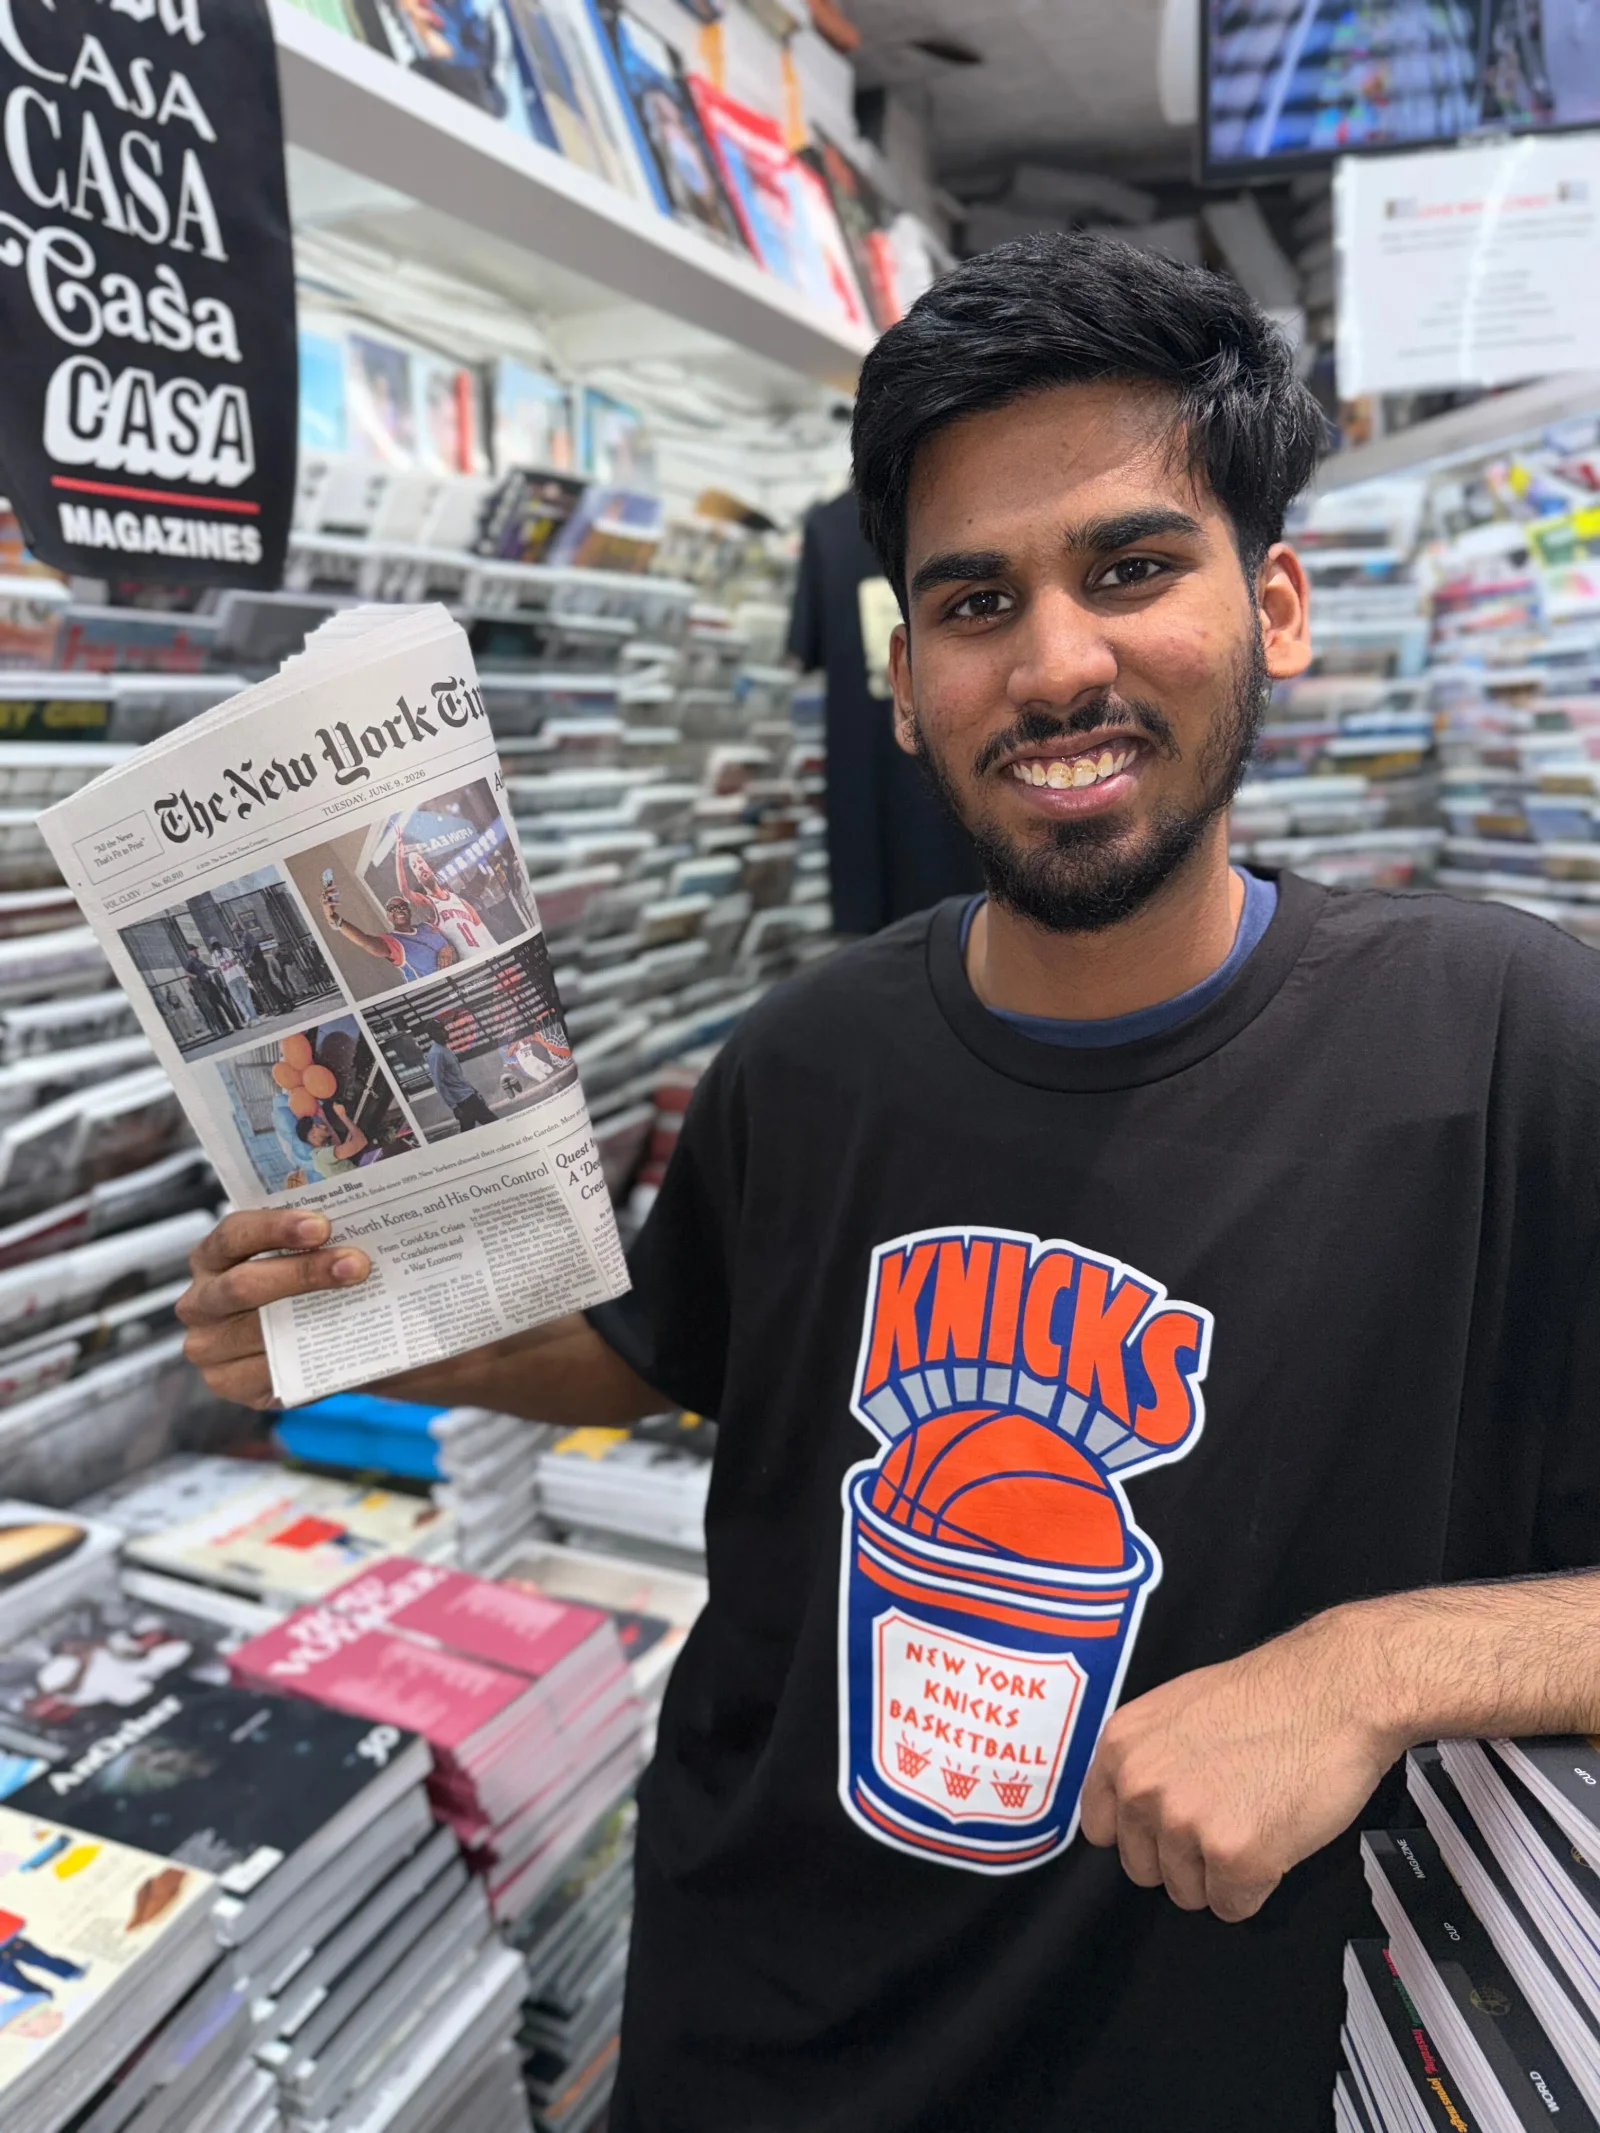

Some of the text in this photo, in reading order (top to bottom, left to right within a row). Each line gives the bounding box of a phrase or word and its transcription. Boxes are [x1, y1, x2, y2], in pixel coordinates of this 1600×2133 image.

[5, 85, 229, 262] CASA
[43, 355, 256, 488] CASA
[59, 503, 262, 565] MAGAZINES
[154, 789, 231, 843] The
[223, 758, 319, 820] New
[314, 695, 440, 786] York
[322, 792, 366, 816] TUESDAY,
[367, 781, 393, 797] JUNE
[403, 769, 425, 783] 2026
[106, 839, 116, 847] the
[115, 830, 133, 842] News
[521, 1133, 533, 1142] the
[560, 1113, 576, 1124] More
[556, 1142, 589, 1168] Quest
[569, 1171, 580, 1186] A
[300, 1190, 327, 1207] Orange
[328, 1186, 343, 1197] and
[343, 1179, 363, 1192] Blue
[345, 1162, 549, 1237] North Korea, and His Own Control
[377, 1222, 466, 1254] From Covid-Era Crises
[392, 1236, 464, 1263] to Crackdowns and
[410, 1260, 426, 1272] War
[427, 1251, 463, 1267] Economy
[863, 1235, 1204, 1446] KNICKS
[906, 1642, 1046, 1700] NEW YORK
[924, 1679, 1020, 1728] KNICKS
[890, 1699, 1047, 1765] BASKETBALL
[1574, 1768, 1596, 1785] CUP
[1397, 1838, 1560, 2112] WORLD CUP MAGAZINE
